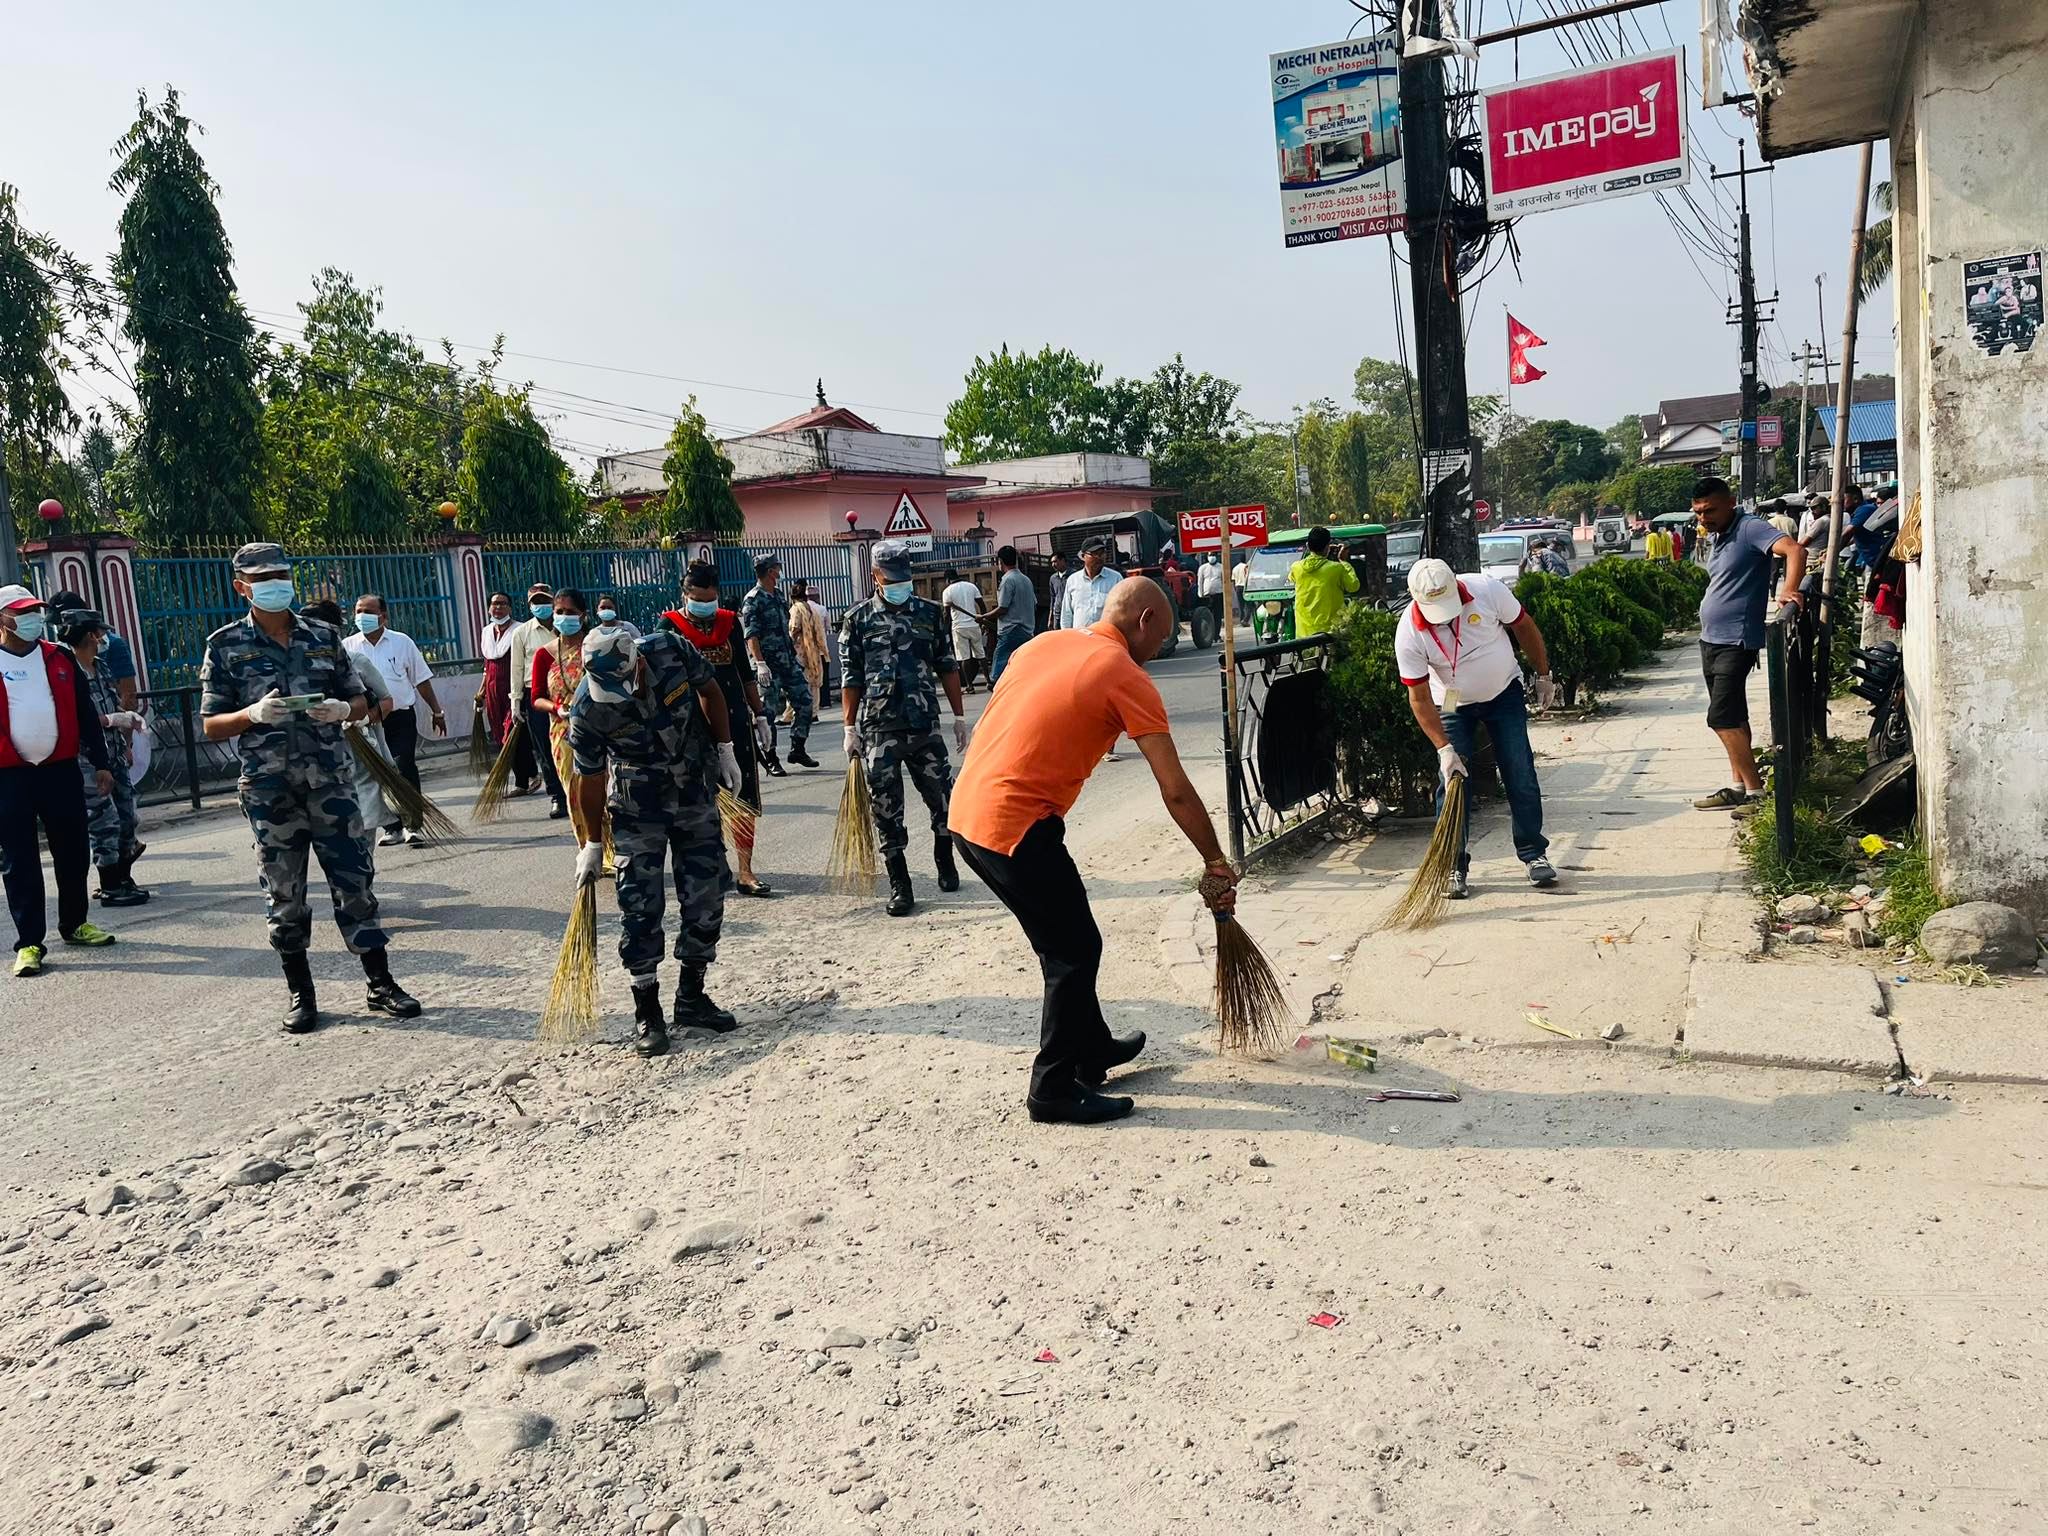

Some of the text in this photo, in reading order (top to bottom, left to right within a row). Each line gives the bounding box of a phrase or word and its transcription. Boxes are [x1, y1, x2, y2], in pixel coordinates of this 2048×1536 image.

[1277, 38, 1394, 71] MECHI NETRALAYA
[1312, 65, 1334, 77] (Eye
[1361, 181, 1381, 191] Nepal
[1517, 190, 1561, 208] डाउनलोड
[1298, 202, 1398, 224] +91-9002709680 (Airtel)
[1341, 217, 1404, 236] VISIT AGAIN
[1287, 230, 1338, 245] THANK YOU
[1180, 512, 1221, 531] पैदल
[905, 540, 928, 549] Slow
